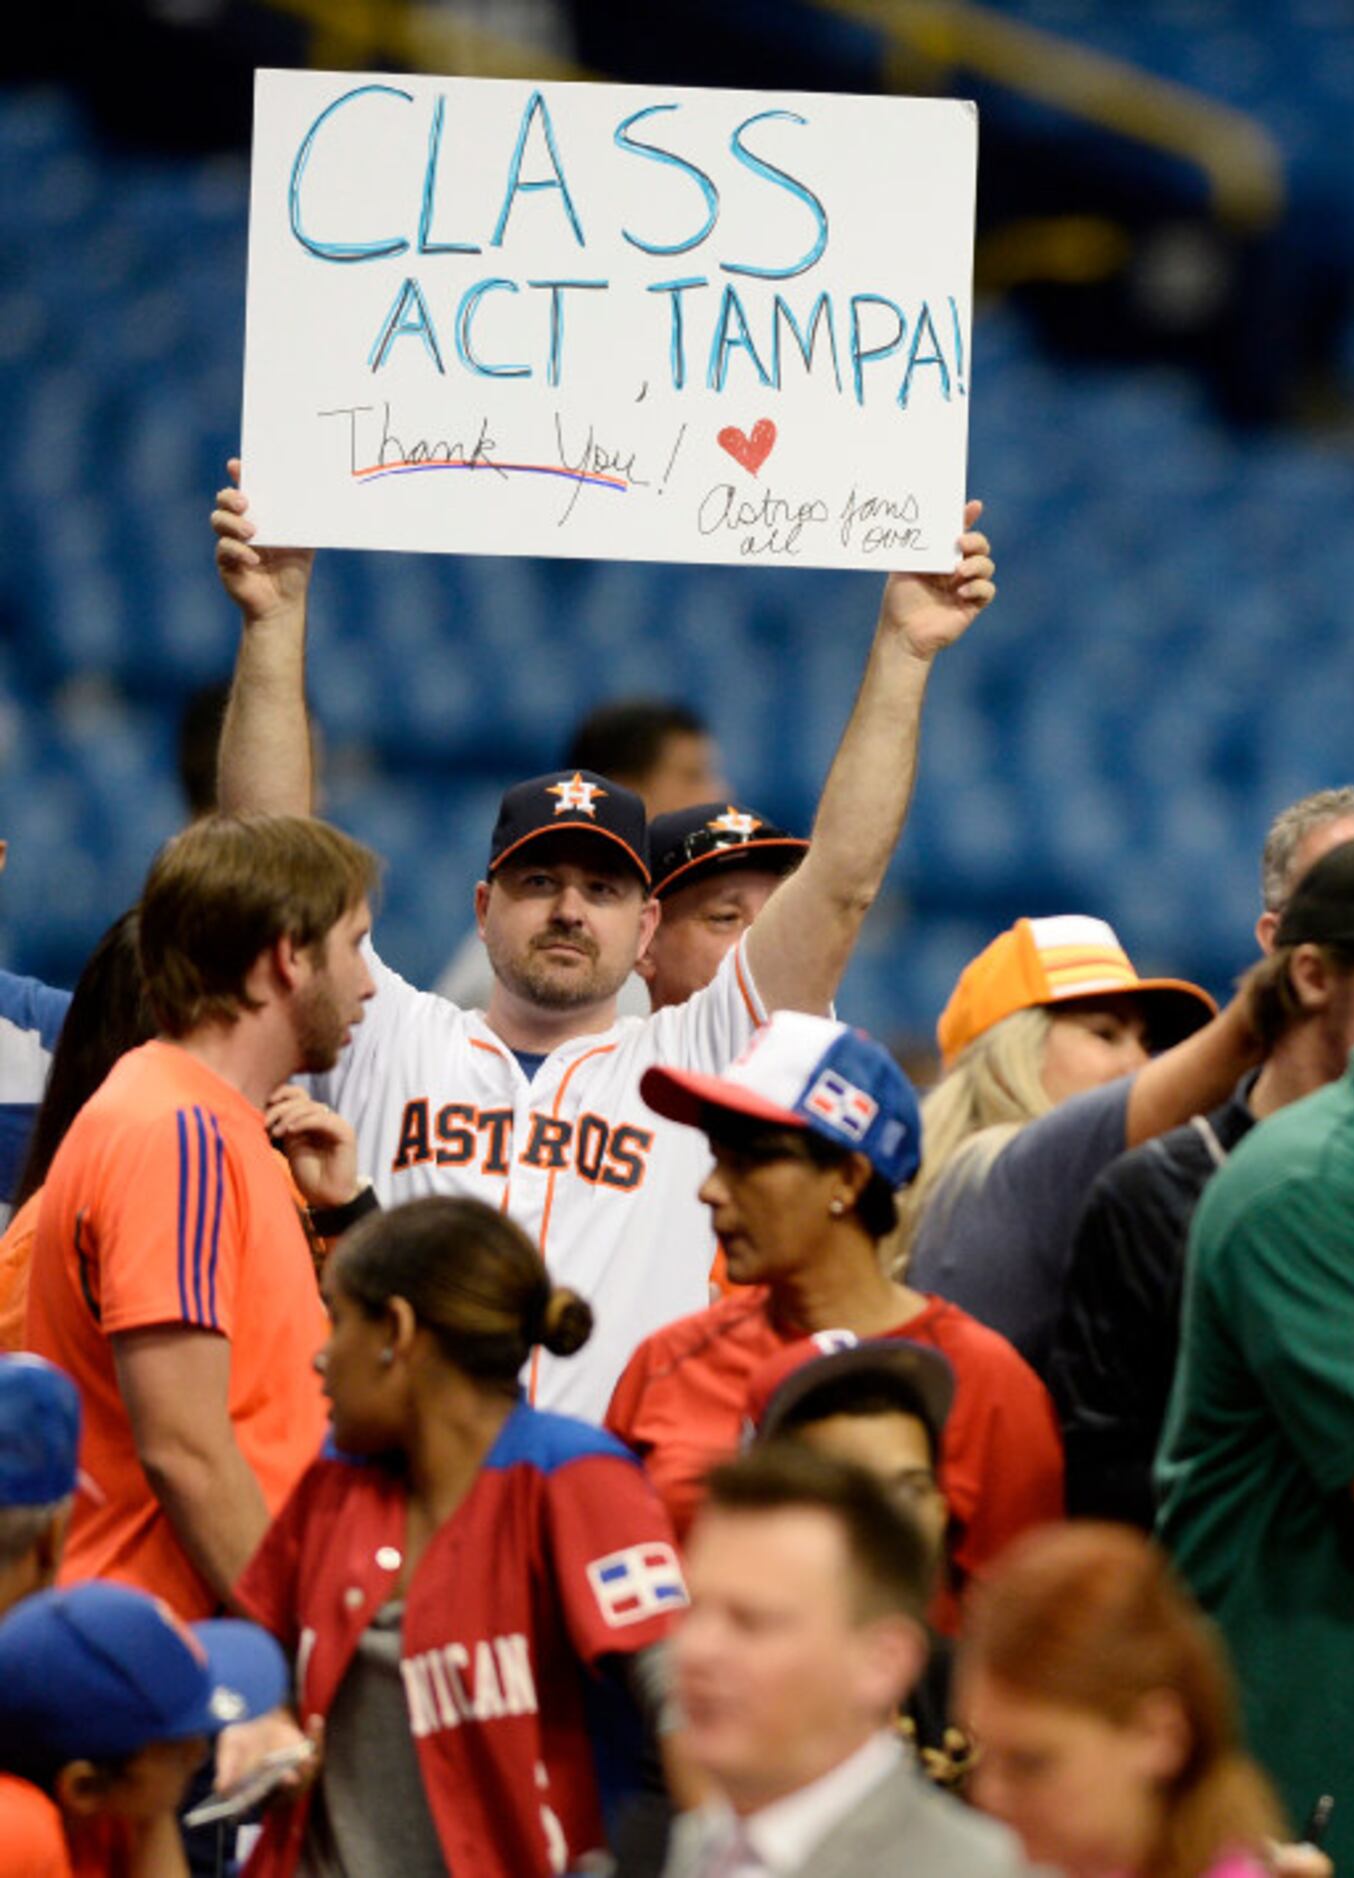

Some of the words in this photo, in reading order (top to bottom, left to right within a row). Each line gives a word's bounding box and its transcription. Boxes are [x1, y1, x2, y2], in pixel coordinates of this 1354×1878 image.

[290, 85, 829, 280] CLASS
[647, 276, 967, 410] TAMPA!
[317, 402, 508, 478] Thank
[841, 488, 919, 547] fans
[555, 782, 596, 811] H
[392, 1097, 655, 1192] ASTROS
